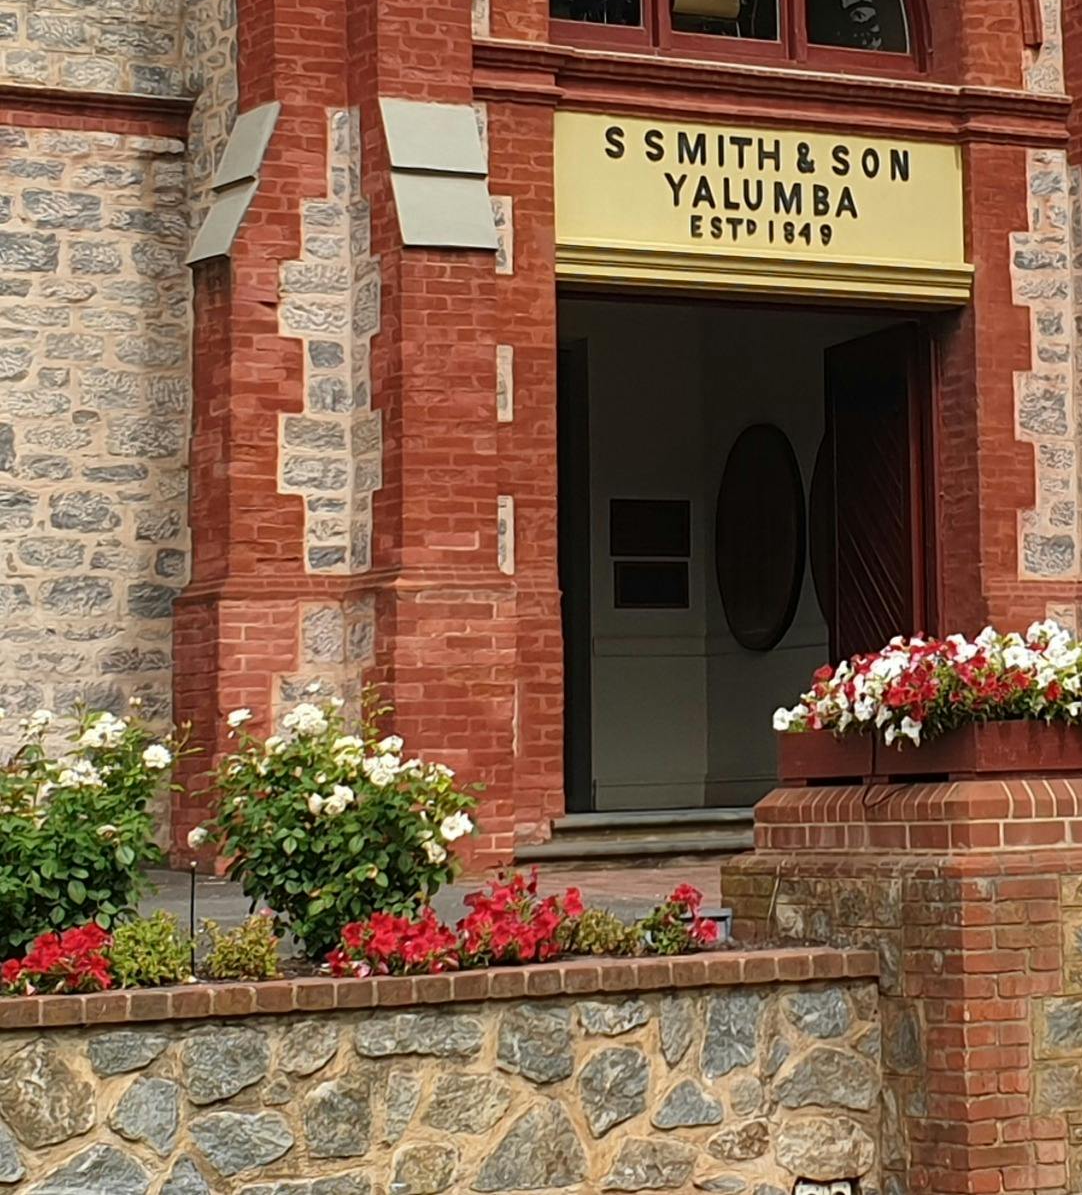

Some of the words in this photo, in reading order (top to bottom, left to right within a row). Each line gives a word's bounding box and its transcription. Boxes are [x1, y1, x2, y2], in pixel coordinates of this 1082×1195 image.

[604, 125, 626, 160] S
[644, 128, 782, 173] SMITH
[796, 141, 817, 174] &
[831, 144, 911, 182] SON
[663, 171, 859, 220] YALUMBA
[768, 219, 834, 247] 1849
